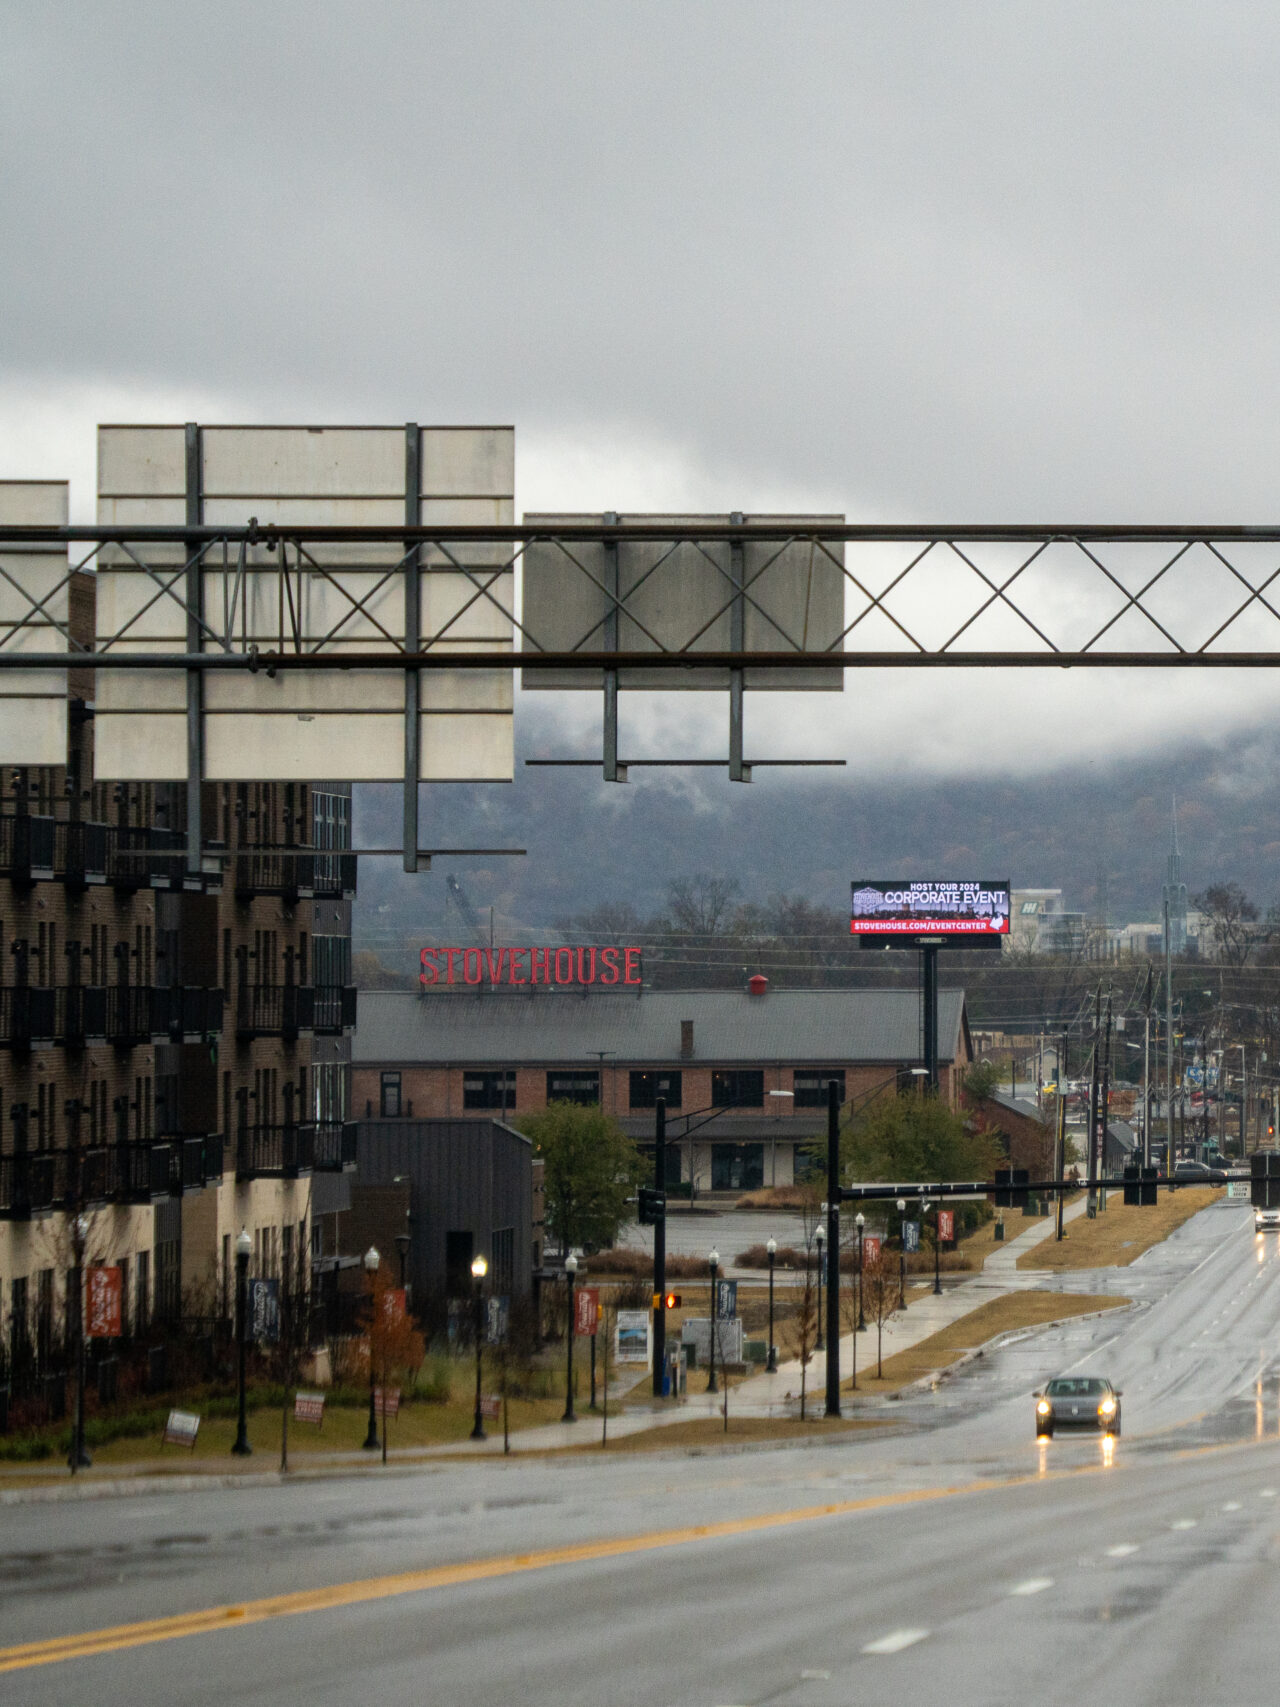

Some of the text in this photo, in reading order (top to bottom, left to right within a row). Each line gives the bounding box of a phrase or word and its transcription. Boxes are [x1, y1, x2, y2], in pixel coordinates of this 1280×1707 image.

[910, 883, 980, 891] HOST YOUR 2024
[884, 892, 960, 904] CORPORATE
[963, 891, 1005, 903] EVENT
[854, 922, 987, 930] STOVEHOUSE.COM/EVENTCENTER
[420, 947, 642, 985] STOVEHOUSE
